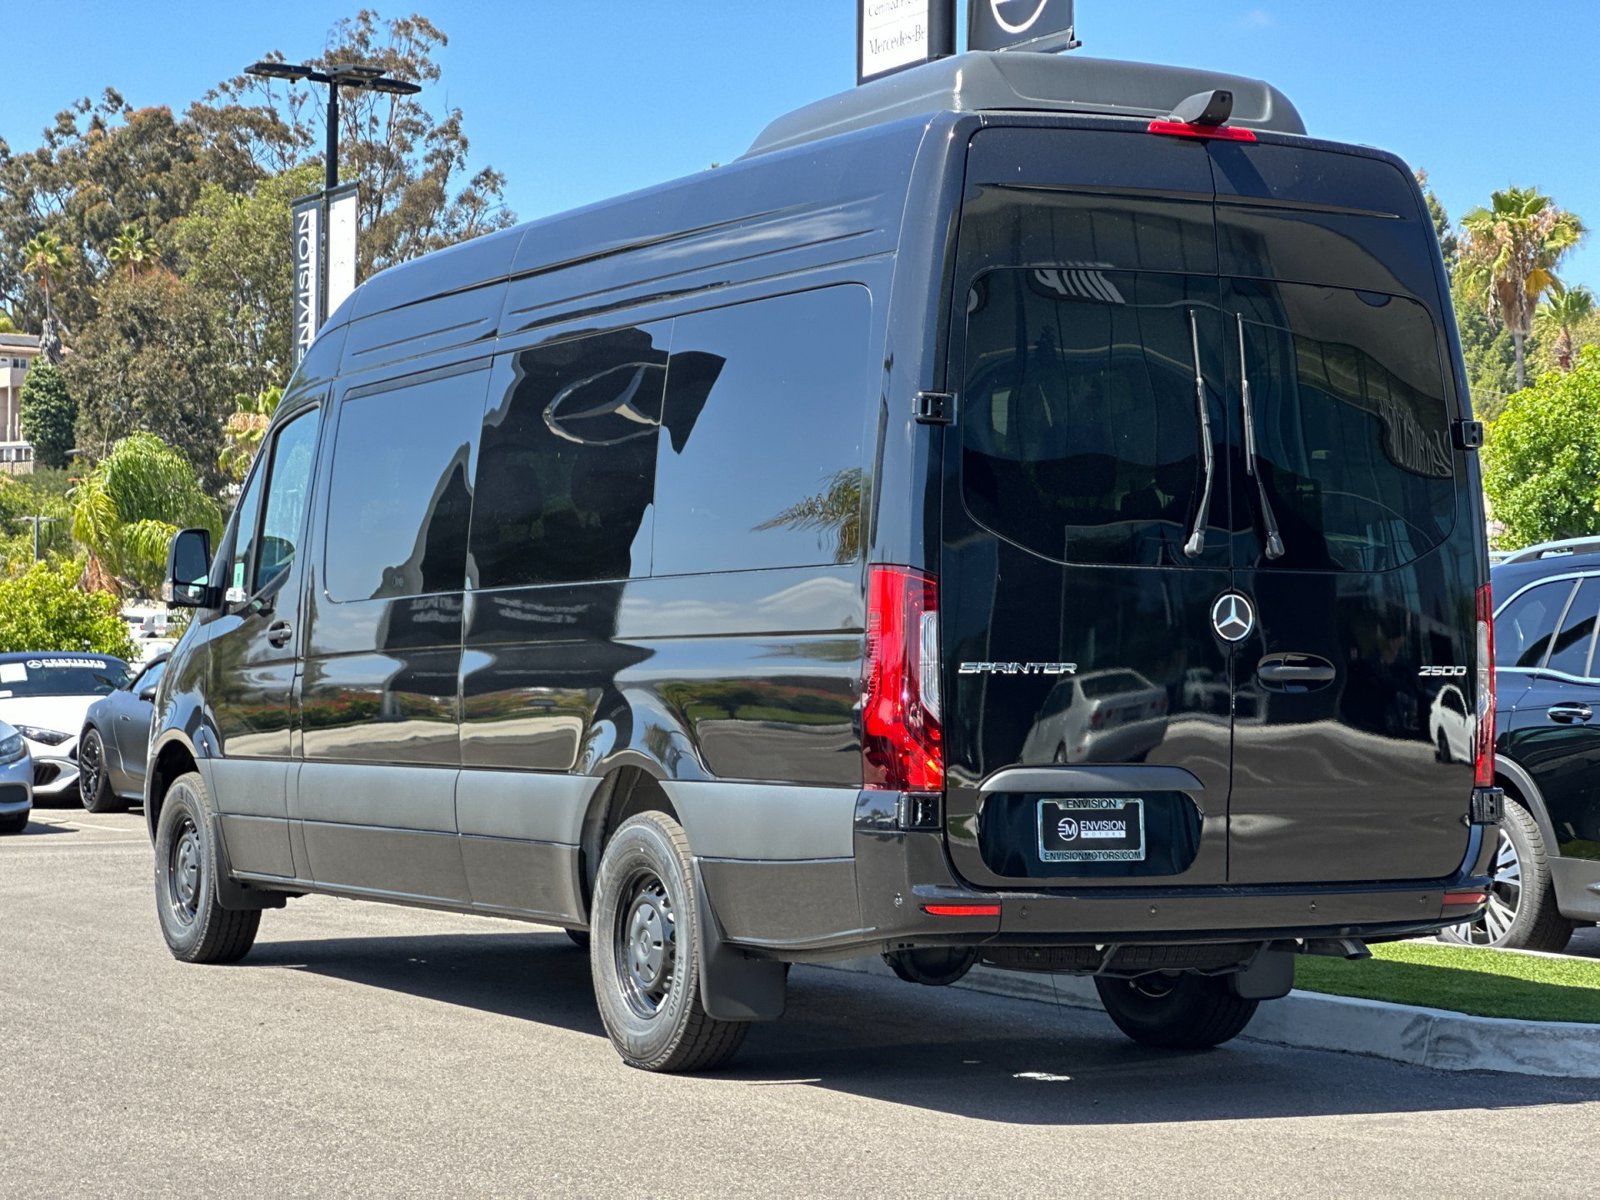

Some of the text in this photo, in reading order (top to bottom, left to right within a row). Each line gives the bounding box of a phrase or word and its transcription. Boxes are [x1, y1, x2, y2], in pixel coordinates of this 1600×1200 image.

[958, 662, 1078, 674] SPRINTER
[1418, 666, 1467, 676] 2500
[1066, 799, 1117, 809] ENVISION
[1080, 821, 1126, 831] ENVISION
[1044, 851, 1141, 861] ENVISIONMOTORS.COM
